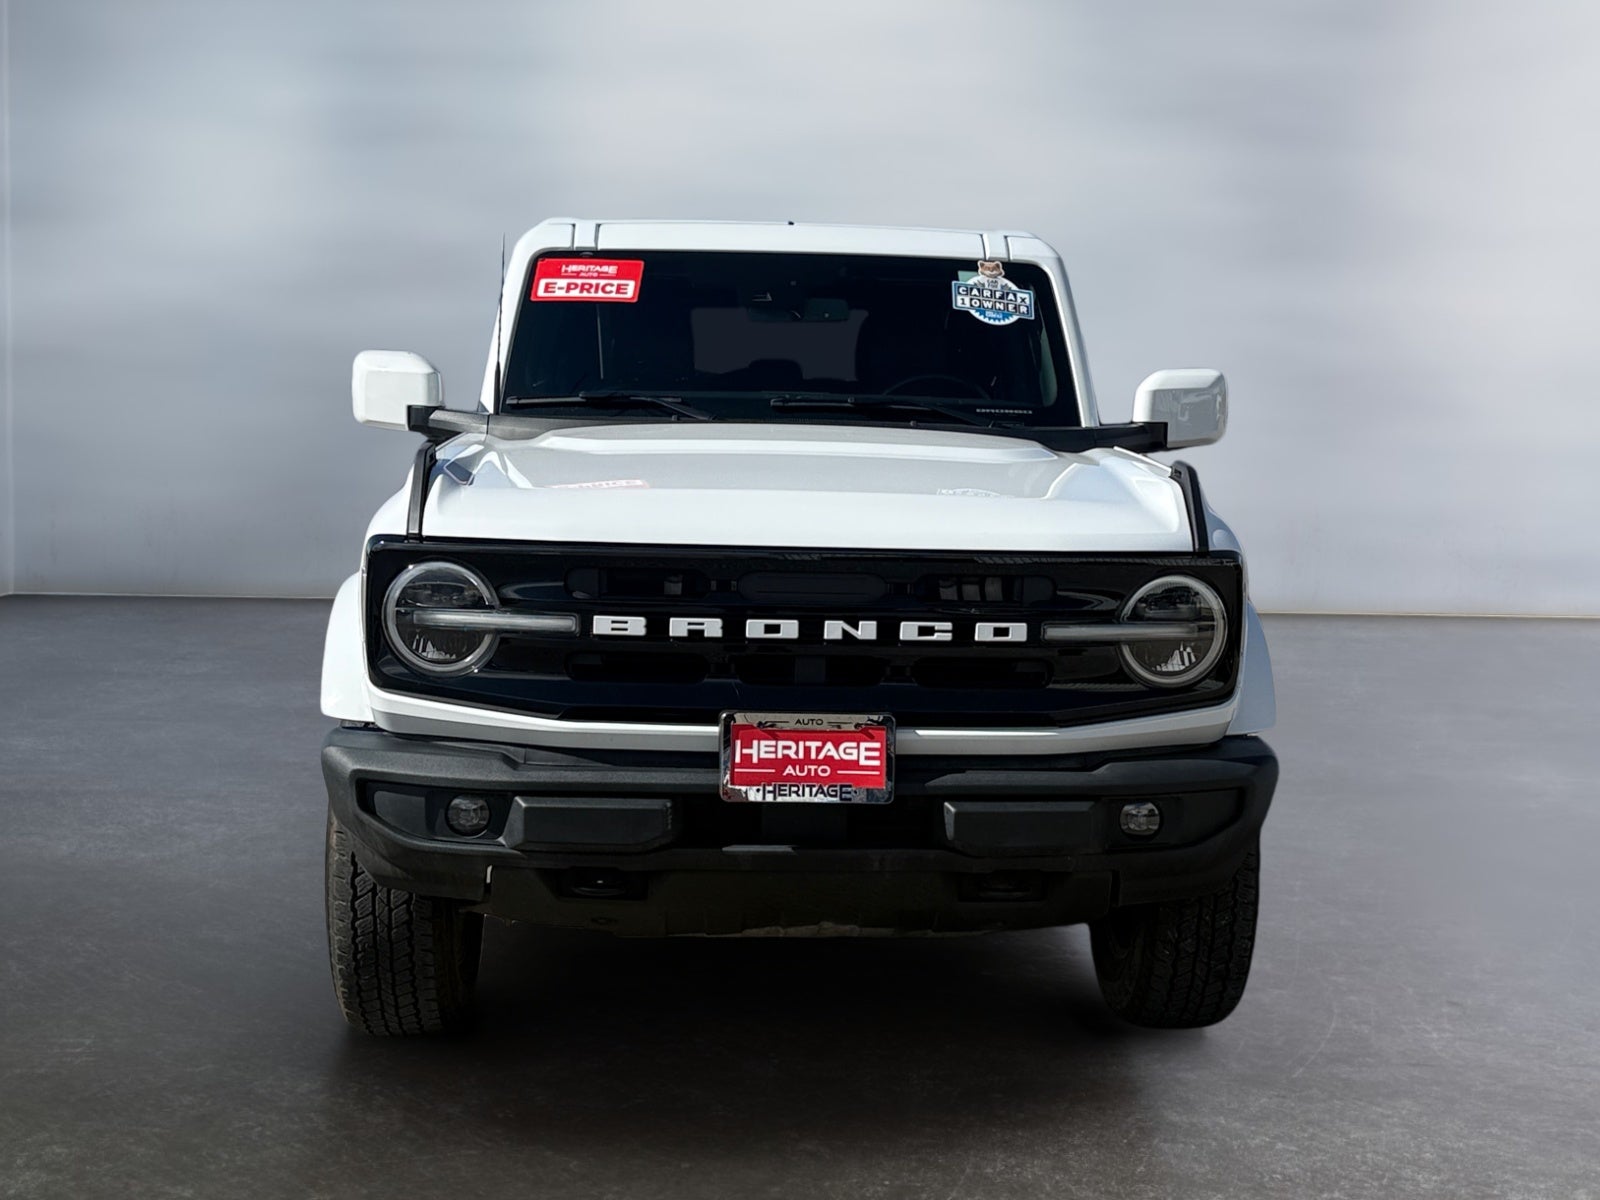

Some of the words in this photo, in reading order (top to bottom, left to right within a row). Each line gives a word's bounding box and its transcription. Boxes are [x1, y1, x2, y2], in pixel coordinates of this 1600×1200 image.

[561, 264, 618, 273] HERITAGE
[543, 282, 629, 295] E-PRICE
[958, 286, 1027, 304] CARFAX
[960, 297, 968, 306] 1
[971, 299, 1028, 315] OWNER
[593, 615, 1027, 641] BRONCO
[794, 718, 824, 726] AUTO
[734, 739, 881, 766] HERITAGE
[782, 764, 831, 777] AUTO
[761, 783, 853, 801] HERITAGE
